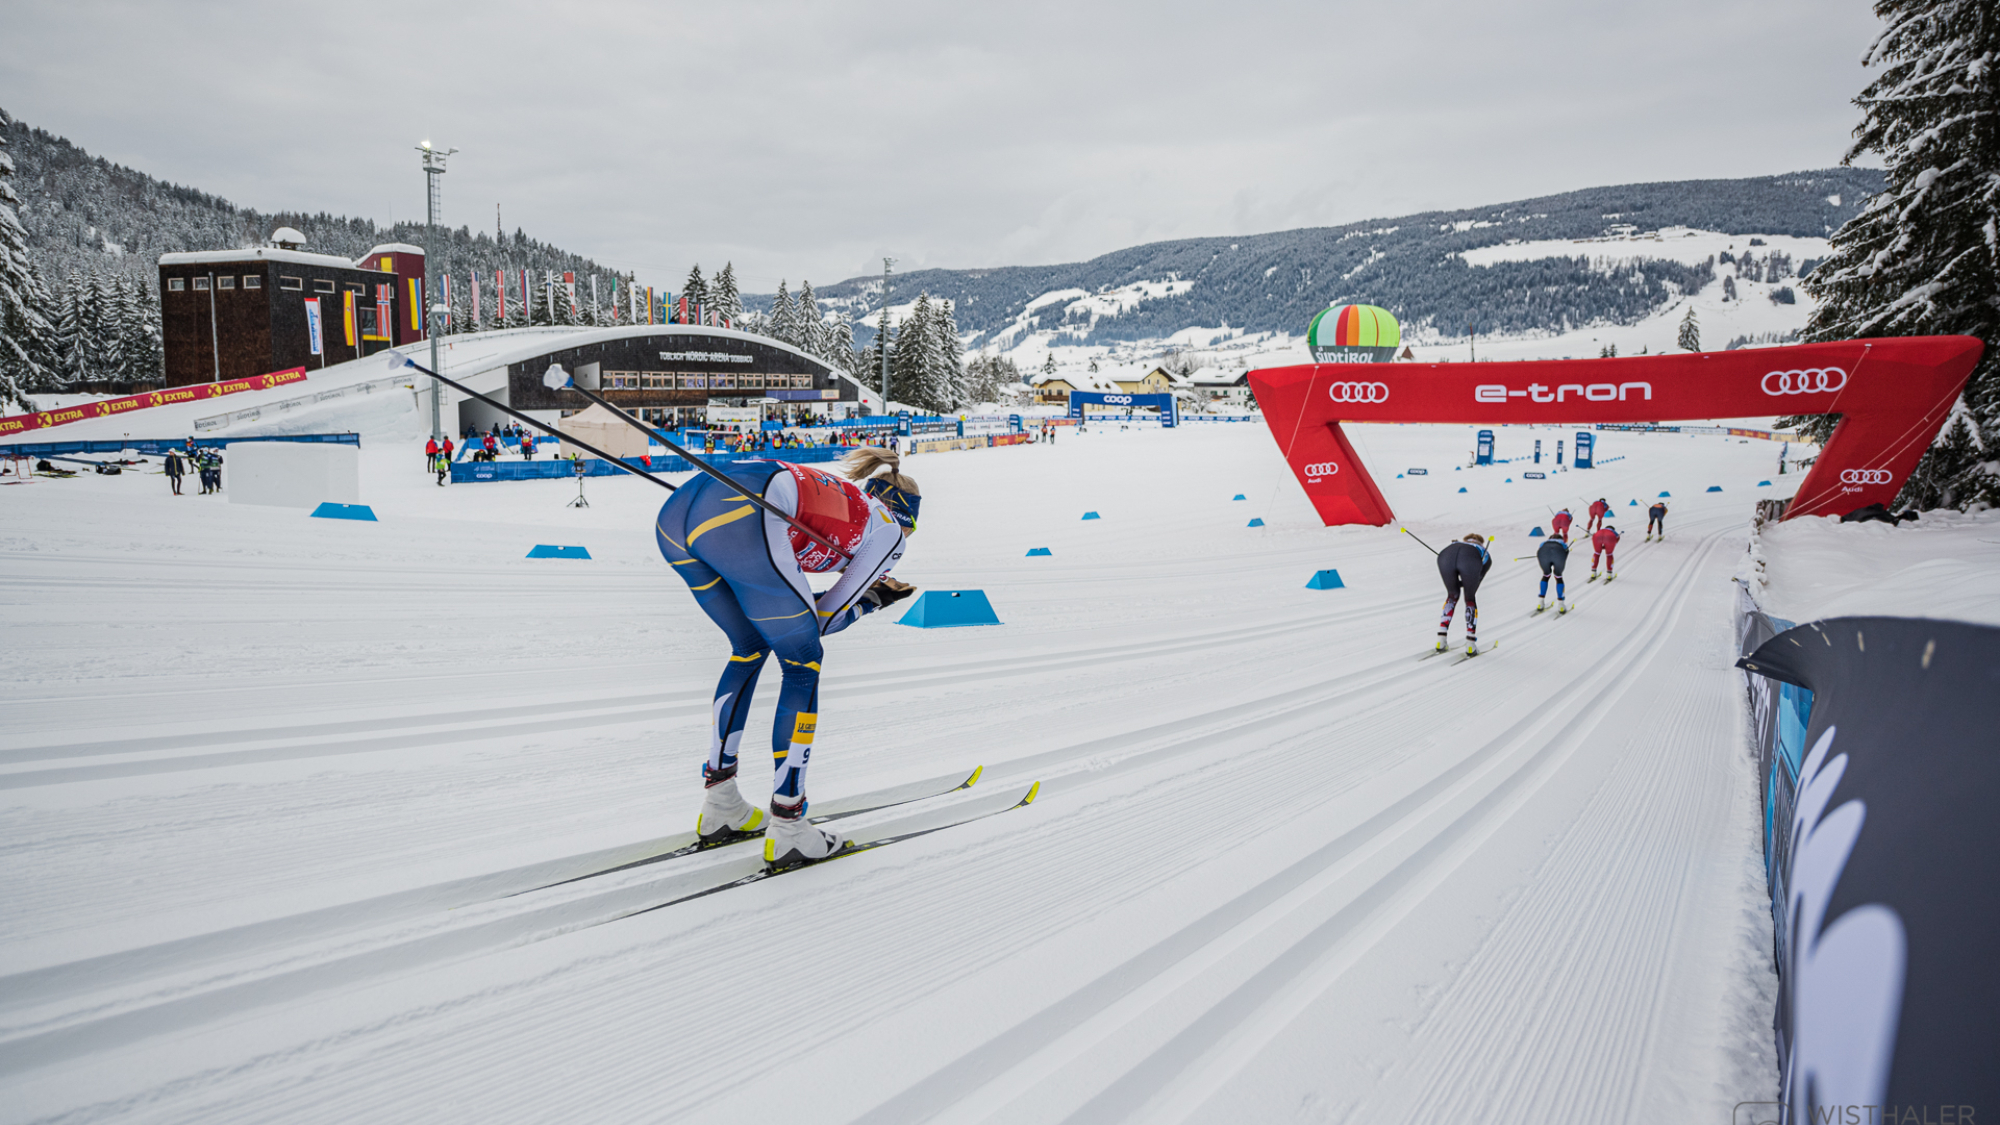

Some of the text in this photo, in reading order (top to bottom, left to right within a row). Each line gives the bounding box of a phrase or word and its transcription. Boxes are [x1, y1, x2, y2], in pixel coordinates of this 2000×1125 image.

[686, 350, 708, 362] NORDIC
[710, 352, 730, 363] ARENA
[276, 371, 301, 382] EXTRA
[224, 382, 251, 393] EXTRA
[1474, 382, 1652, 402] e-tron
[164, 390, 194, 402] EXTRA
[1103, 395, 1132, 405] coop
[111, 400, 139, 412] EXTRA
[54, 410, 84, 422] EXTRA
